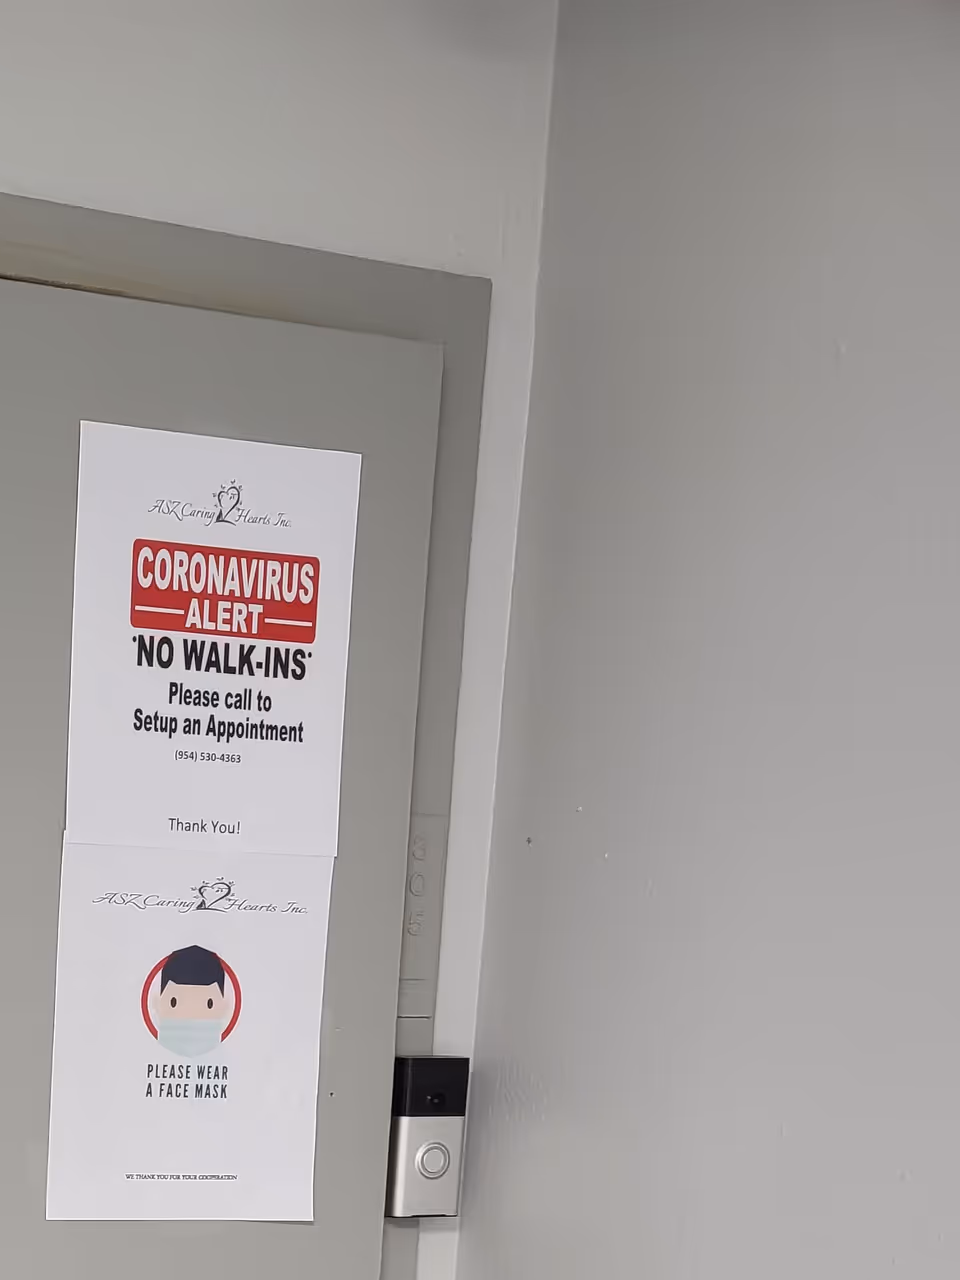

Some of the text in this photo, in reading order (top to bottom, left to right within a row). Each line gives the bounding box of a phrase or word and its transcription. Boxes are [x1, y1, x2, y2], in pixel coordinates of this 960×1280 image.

[148, 499, 292, 527] ASZ Caring Hearts Inc.
[137, 546, 315, 604] CORONAVIRUS
[185, 598, 264, 634] ALERT
[168, 682, 272, 712] Please call to
[133, 708, 304, 743] Setup an Appointment
[174, 750, 242, 763] (954) 530-4363
[168, 818, 241, 835] Thank You!
[92, 892, 308, 914] ASZ Caring Hearts Inc.
[146, 1063, 228, 1080] PLEASE WEAR
[145, 1082, 228, 1099] A FACE MASK
